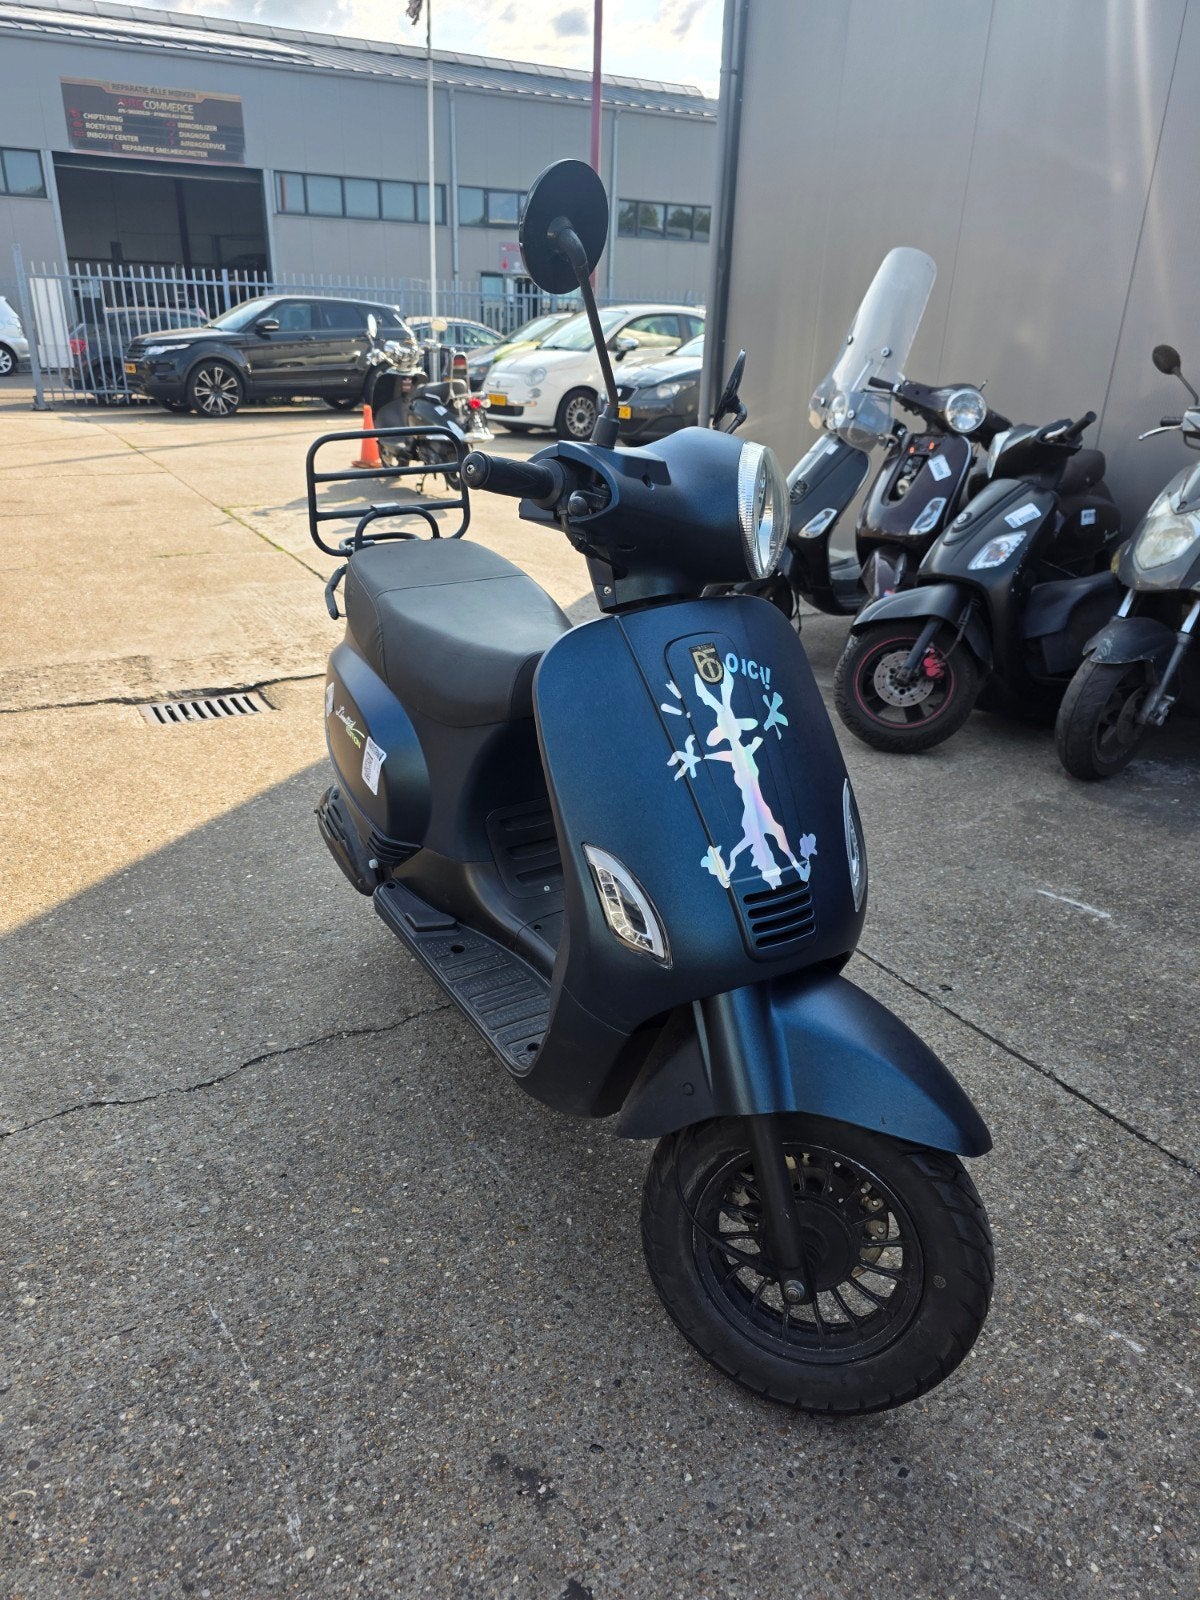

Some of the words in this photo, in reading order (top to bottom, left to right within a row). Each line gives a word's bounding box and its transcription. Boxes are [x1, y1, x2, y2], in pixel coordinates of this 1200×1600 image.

[111, 83, 149, 94] REPARATIE
[150, 87, 167, 96] ALLE
[83, 112, 124, 123] CHIPTUNING
[85, 122, 123, 132] ROETFILTER
[177, 122, 218, 132] IMMOBILIZER
[86, 131, 114, 140] INBOUW
[114, 133, 139, 142] CENTER
[178, 131, 211, 140] DIAGNOSE
[121, 144, 154, 153] REPARATIE
